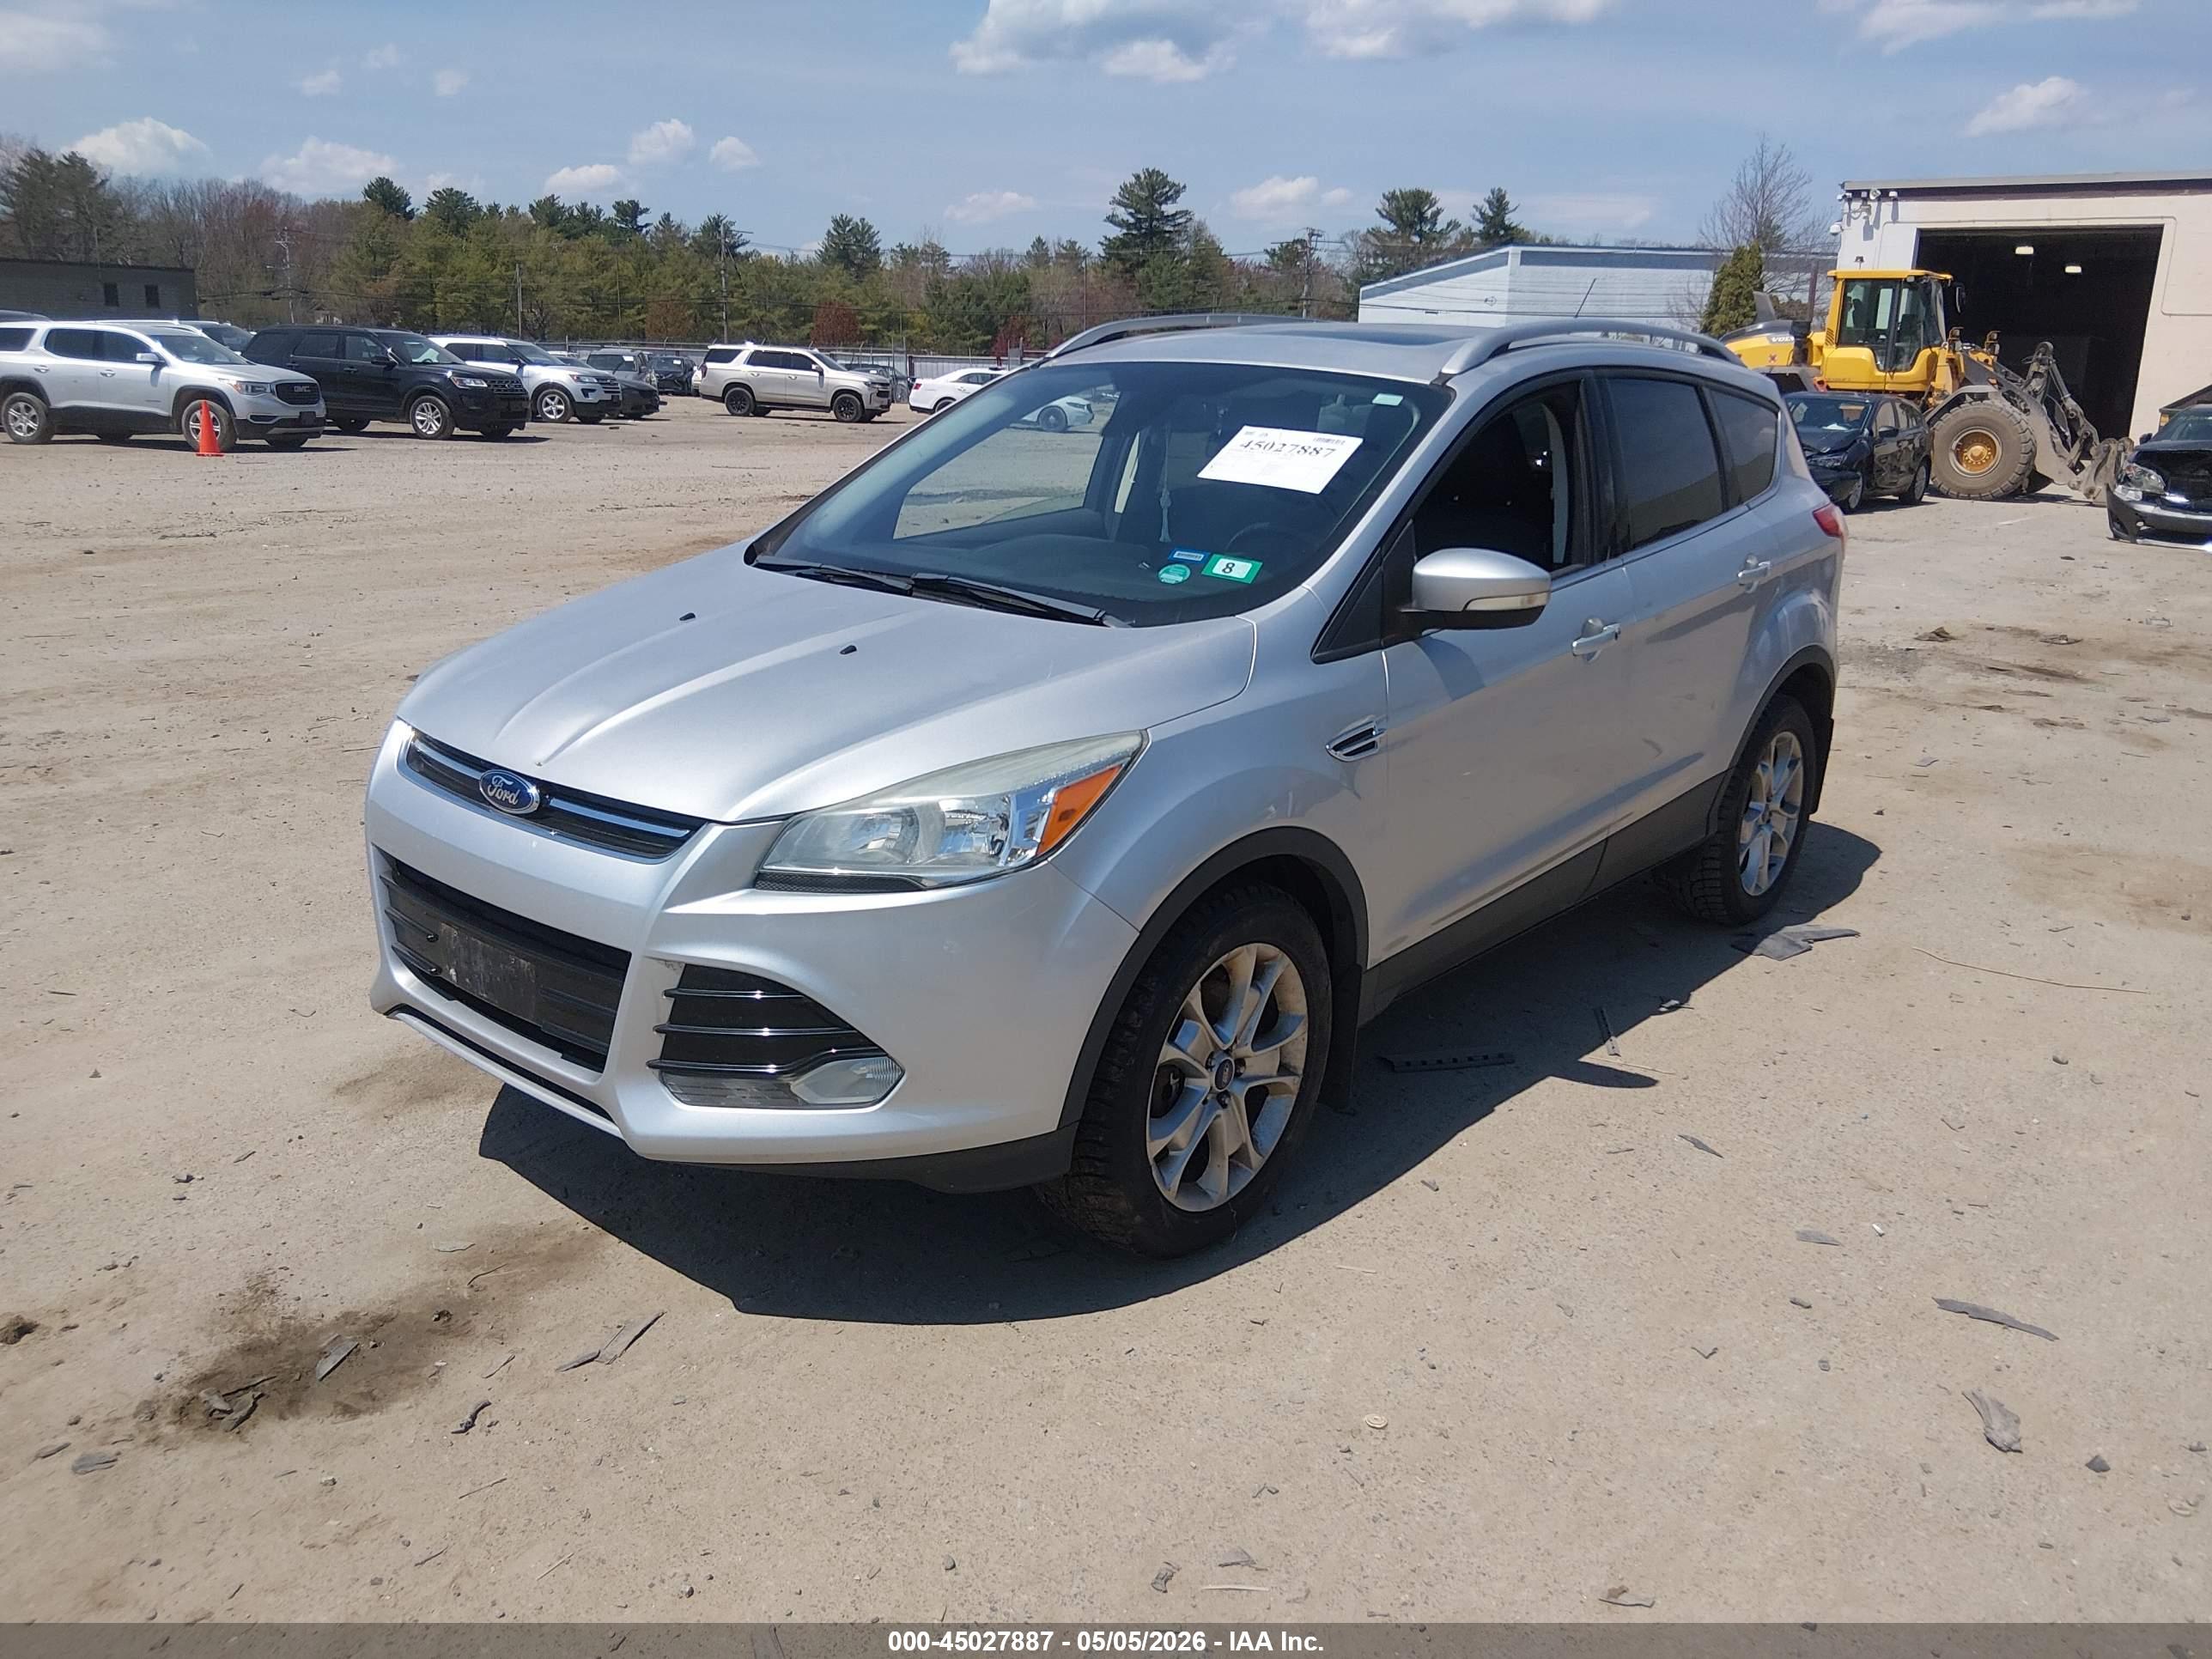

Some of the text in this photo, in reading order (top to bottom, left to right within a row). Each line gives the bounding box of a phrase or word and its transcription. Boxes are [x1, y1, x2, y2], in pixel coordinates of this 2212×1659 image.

[1239, 439, 1336, 458] 45027887
[1222, 562, 1236, 574] 8
[487, 775, 520, 805] Ford
